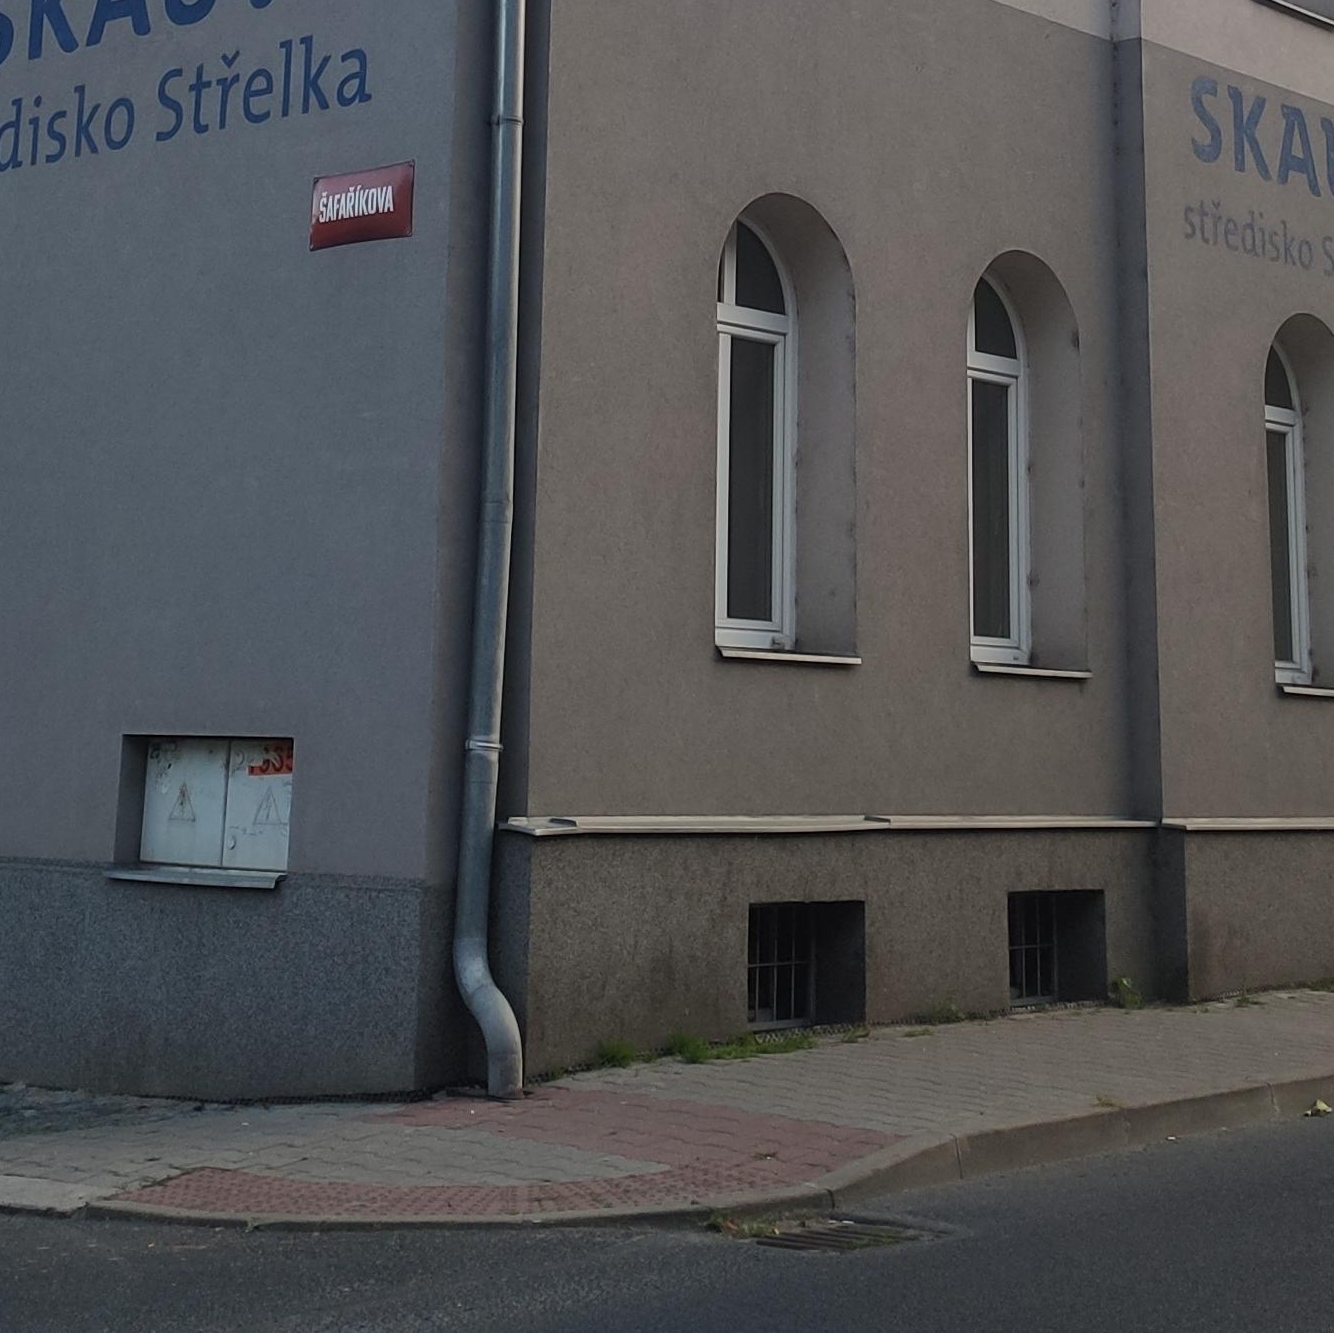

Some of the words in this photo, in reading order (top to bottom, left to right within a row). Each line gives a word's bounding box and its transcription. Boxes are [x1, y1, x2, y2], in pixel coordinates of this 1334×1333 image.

[156, 35, 372, 142] Střelka
[319, 184, 394, 223] ŠAFAŘÍKOVA
[1183, 199, 1314, 271] středisko
